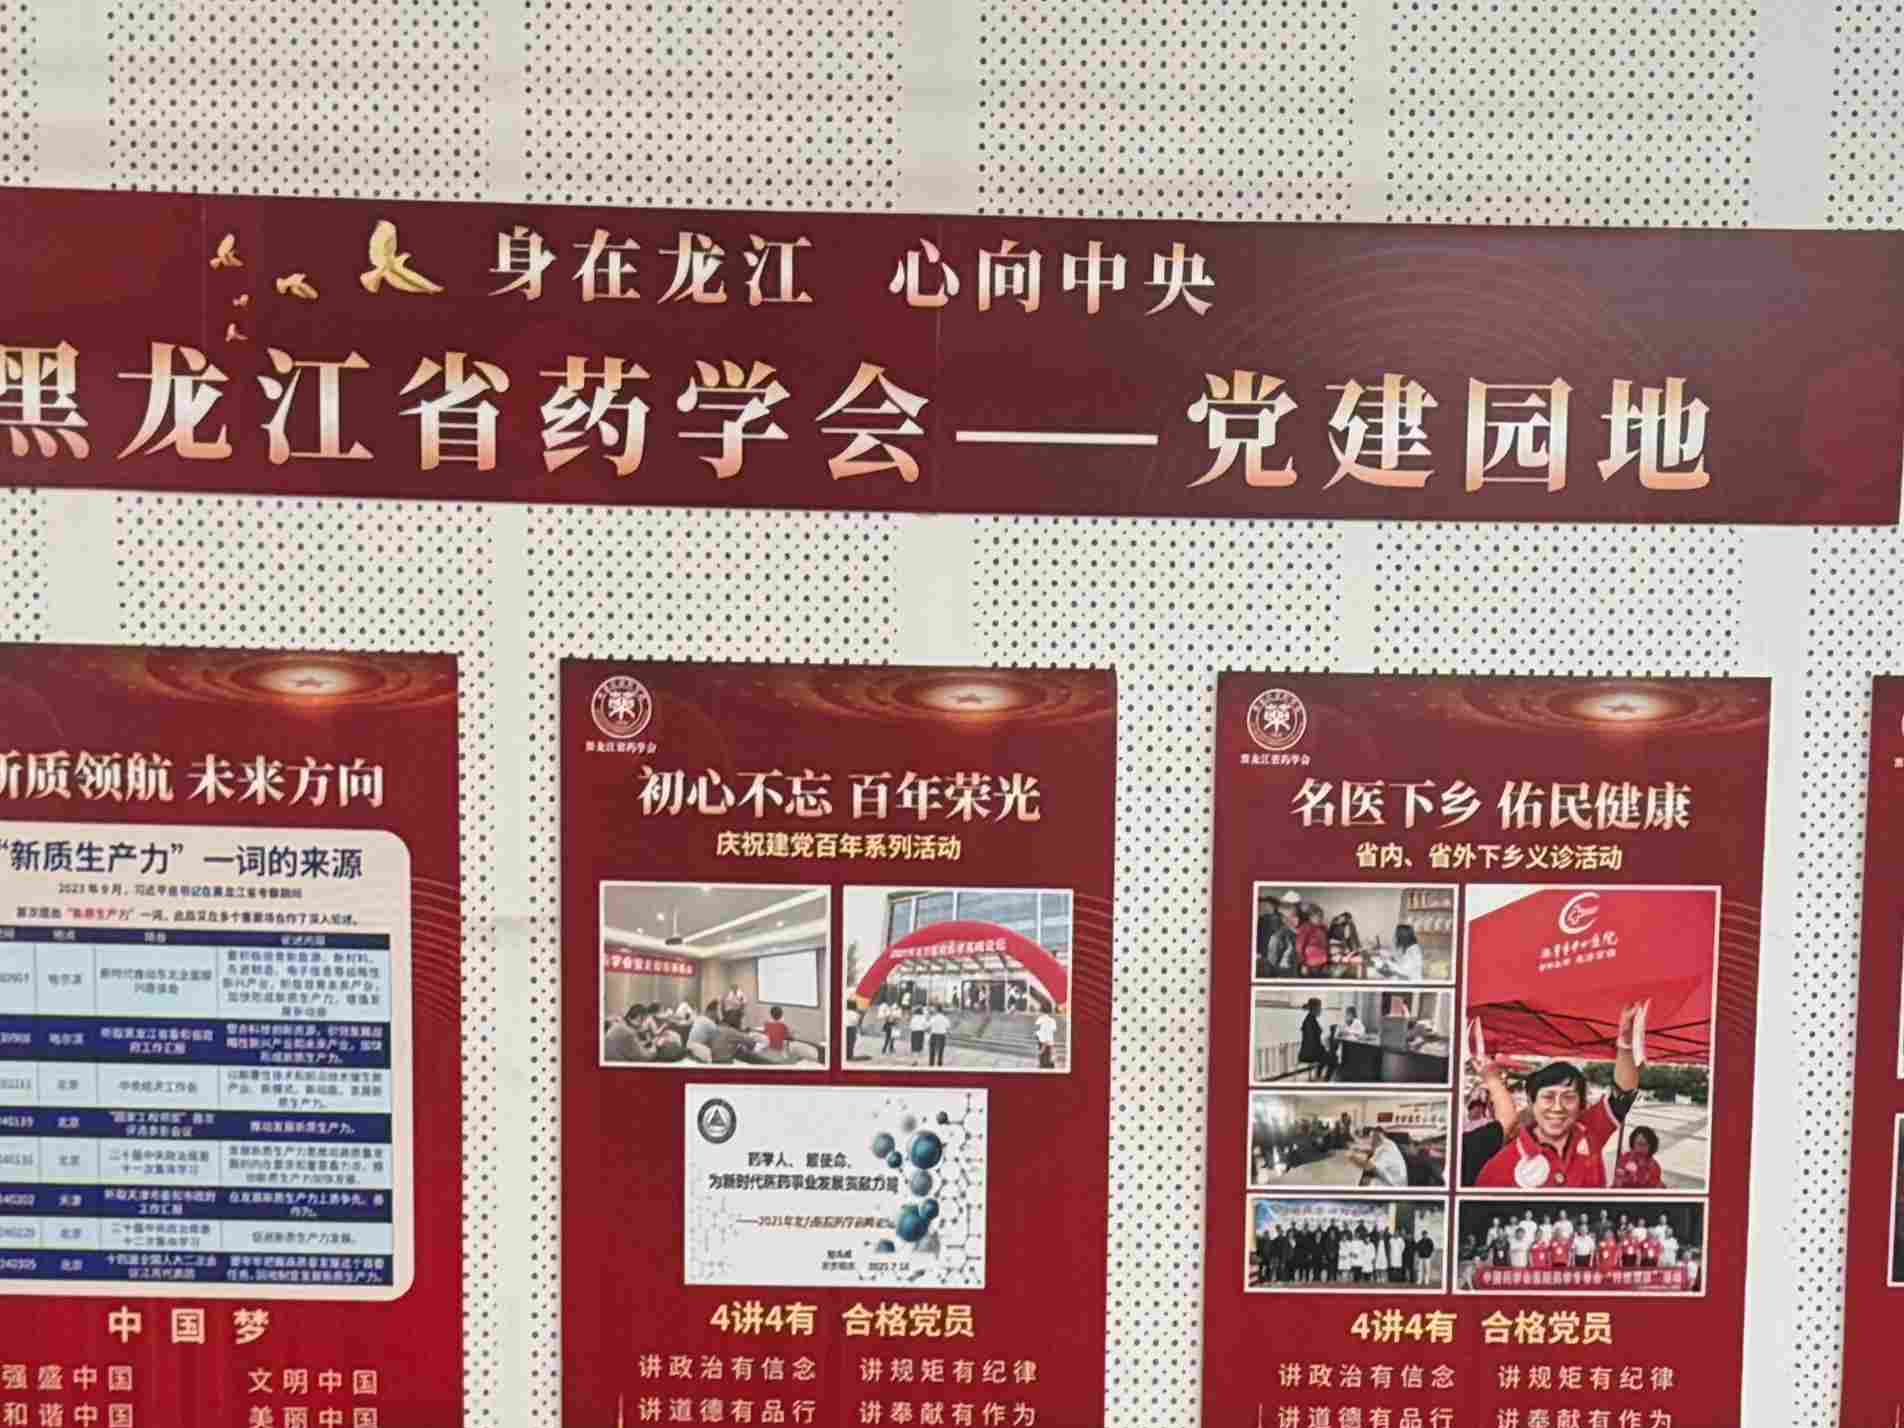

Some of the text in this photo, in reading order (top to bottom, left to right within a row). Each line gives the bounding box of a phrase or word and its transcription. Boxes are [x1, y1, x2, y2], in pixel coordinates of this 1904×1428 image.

[488, 230, 1219, 322] 身在龙江 心向中央
[186, 754, 385, 809] 未来方向
[637, 765, 1042, 823] 初心不忘 百年荣光
[1290, 776, 1693, 832] 名医下乡 佑民健康
[202, 846, 363, 880] 一词的来源
[716, 830, 962, 861] 庆祝建党百年系列活动
[107, 1307, 271, 1345] 中国梦
[710, 1300, 975, 1338] 4讲4有 合格党员
[1350, 1309, 1613, 1345] 4讲4有 合格党员
[2, 1365, 380, 1396] 强盛中国 文明中国
[638, 1354, 1038, 1385] 讲政治有信念 讲规矩有纪律
[1278, 1362, 1674, 1391] 讲政治有信念 讲规矩有纪律
[3, 1403, 134, 1428] 和谐中国
[637, 1397, 1037, 1427] 讲道德有品行 讲奉献有作为
